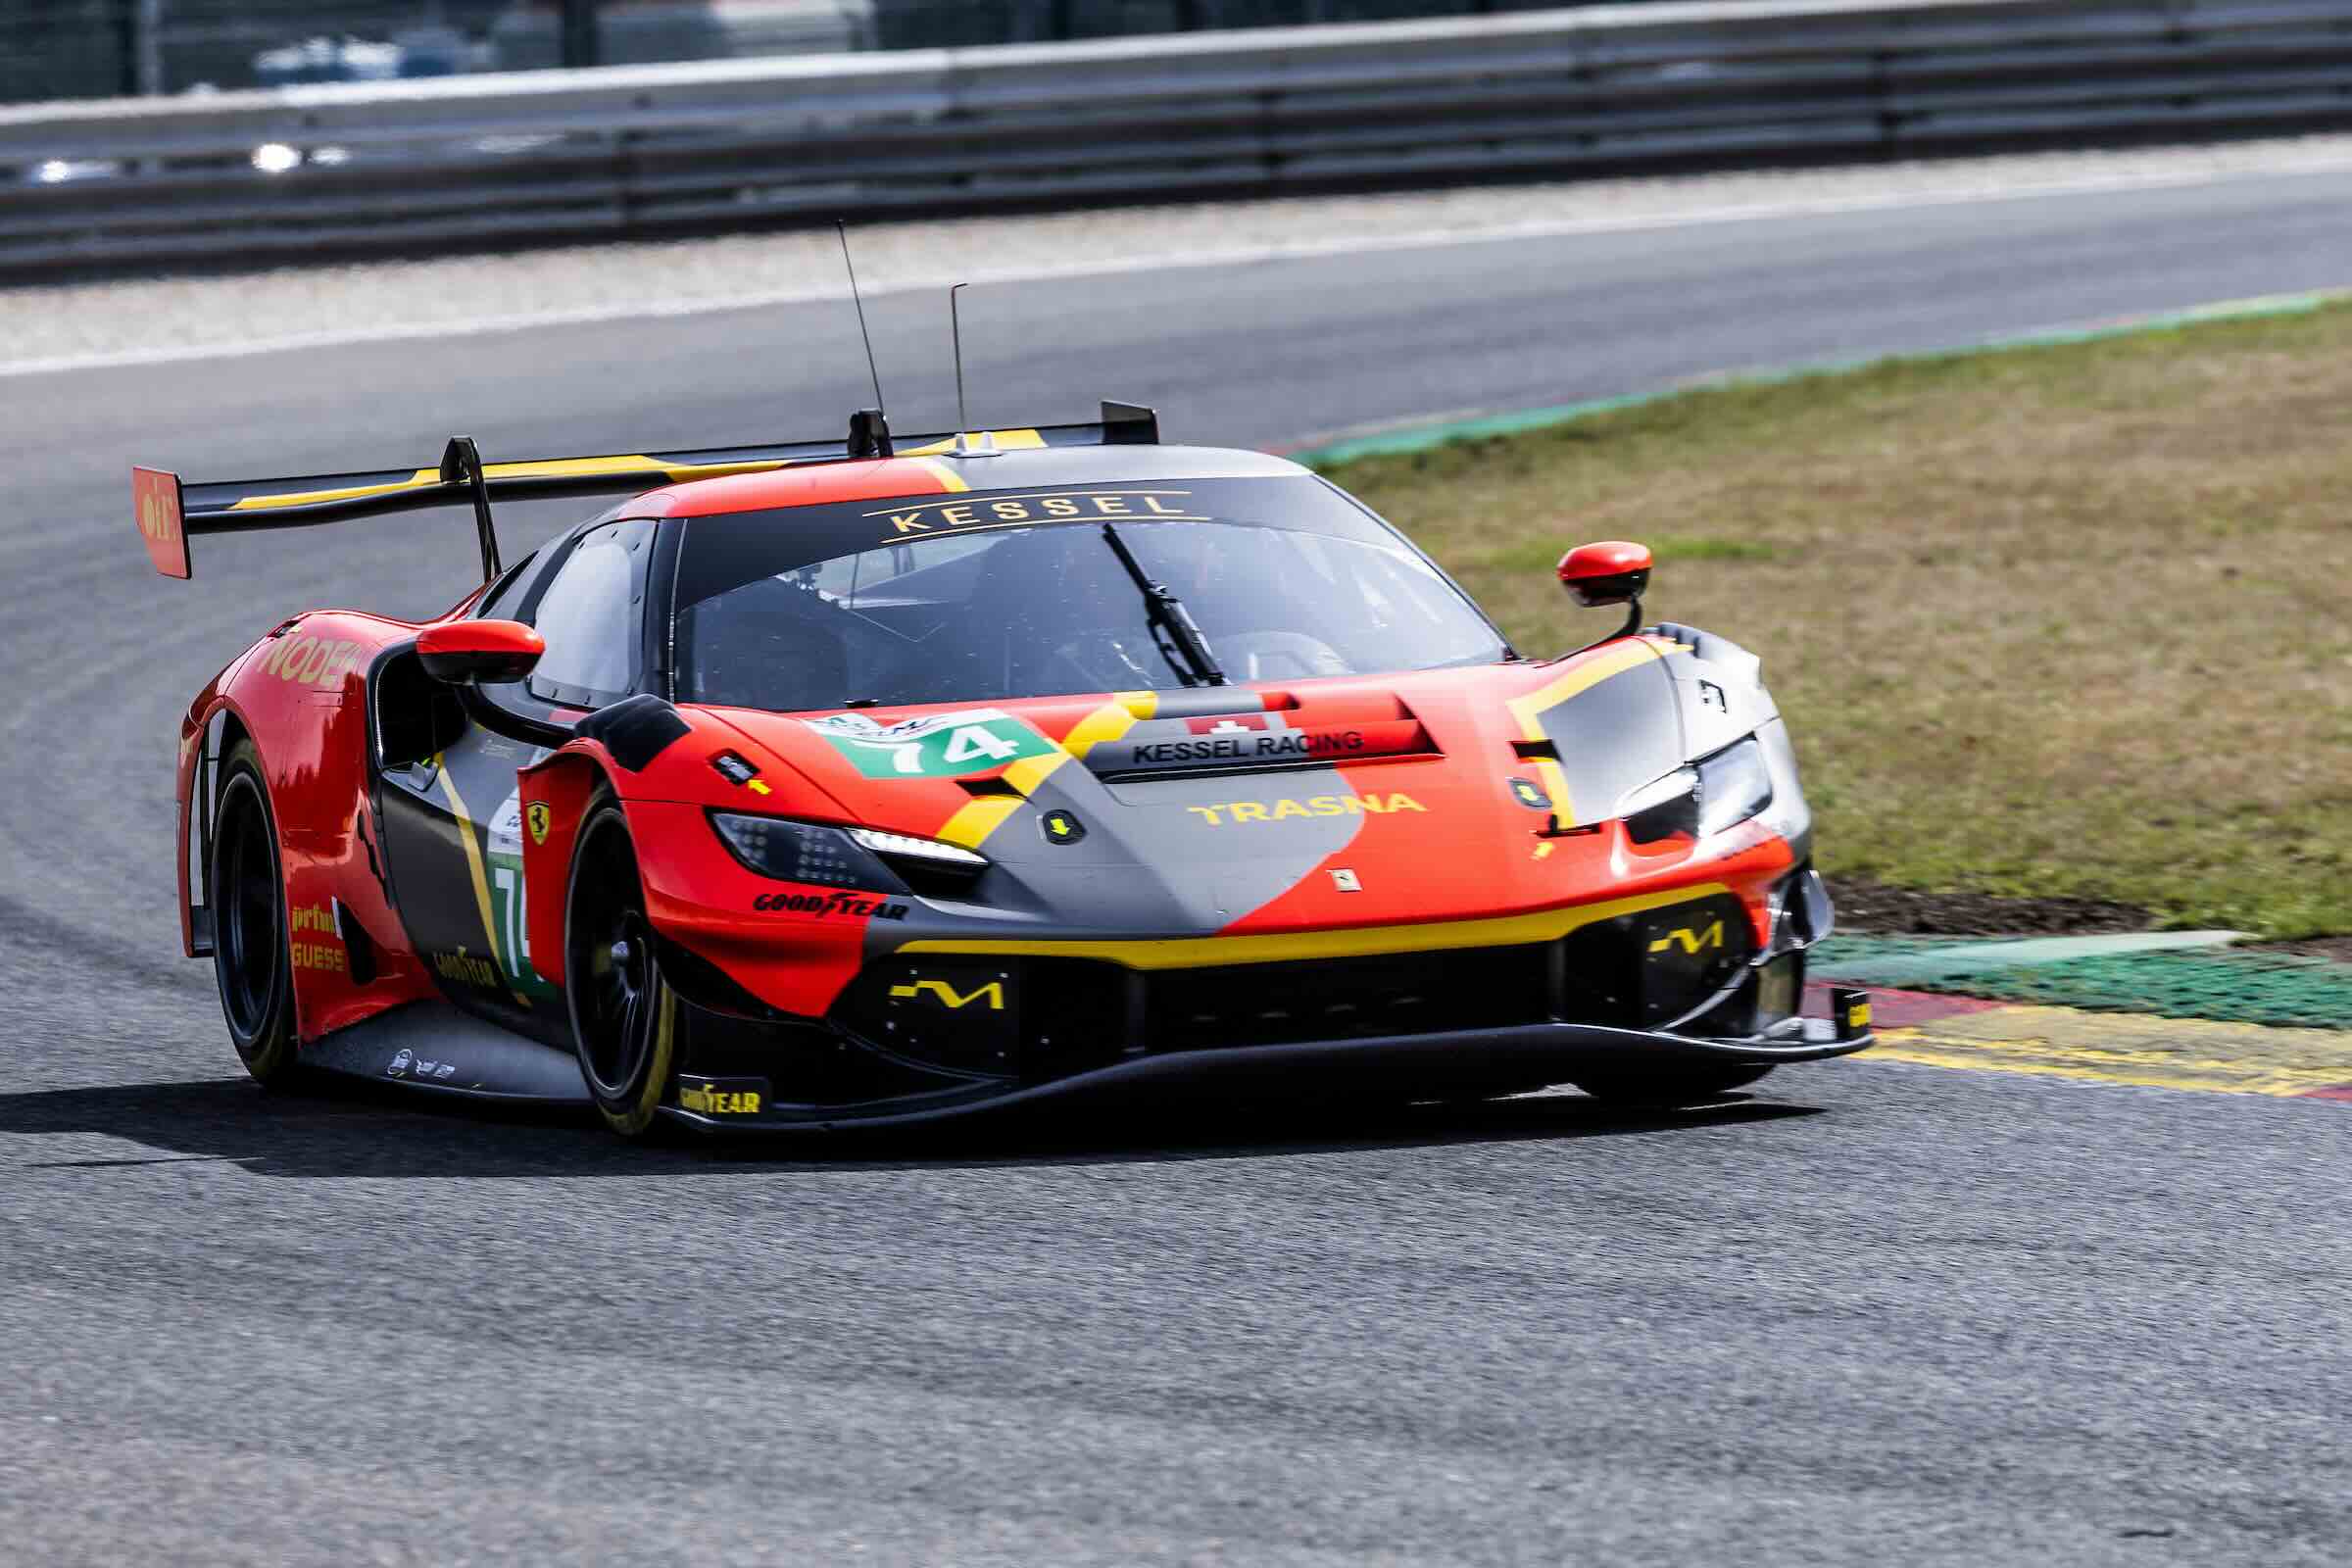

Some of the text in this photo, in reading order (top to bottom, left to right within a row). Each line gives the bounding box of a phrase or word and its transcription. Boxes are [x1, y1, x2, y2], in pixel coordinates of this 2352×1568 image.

[889, 495, 1186, 532] KESSEL
[849, 724, 1020, 774] 74
[1132, 730, 1365, 764] KESSEL RACING
[1187, 792, 1429, 826] TRASNA
[752, 892, 909, 921] GOODYEAR
[291, 942, 345, 972] GUESS
